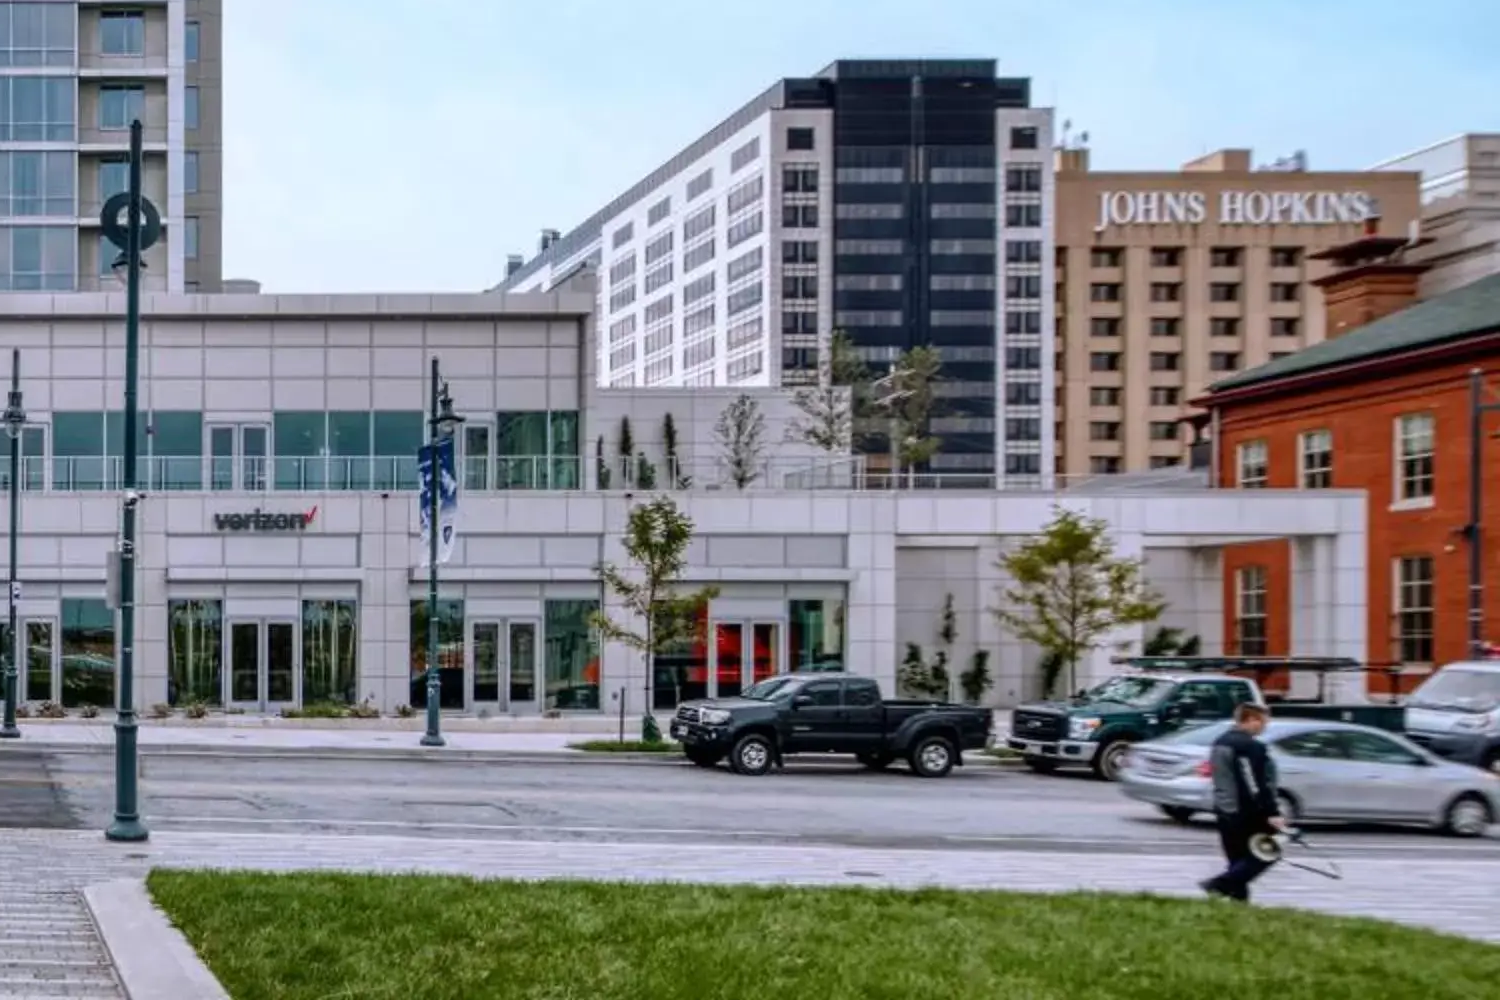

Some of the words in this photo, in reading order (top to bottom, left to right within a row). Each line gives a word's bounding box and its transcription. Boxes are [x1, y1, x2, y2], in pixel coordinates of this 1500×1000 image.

[1093, 190, 1206, 232] JOHNS
[1220, 190, 1372, 224] HOPKINS
[214, 507, 306, 530] verizon
